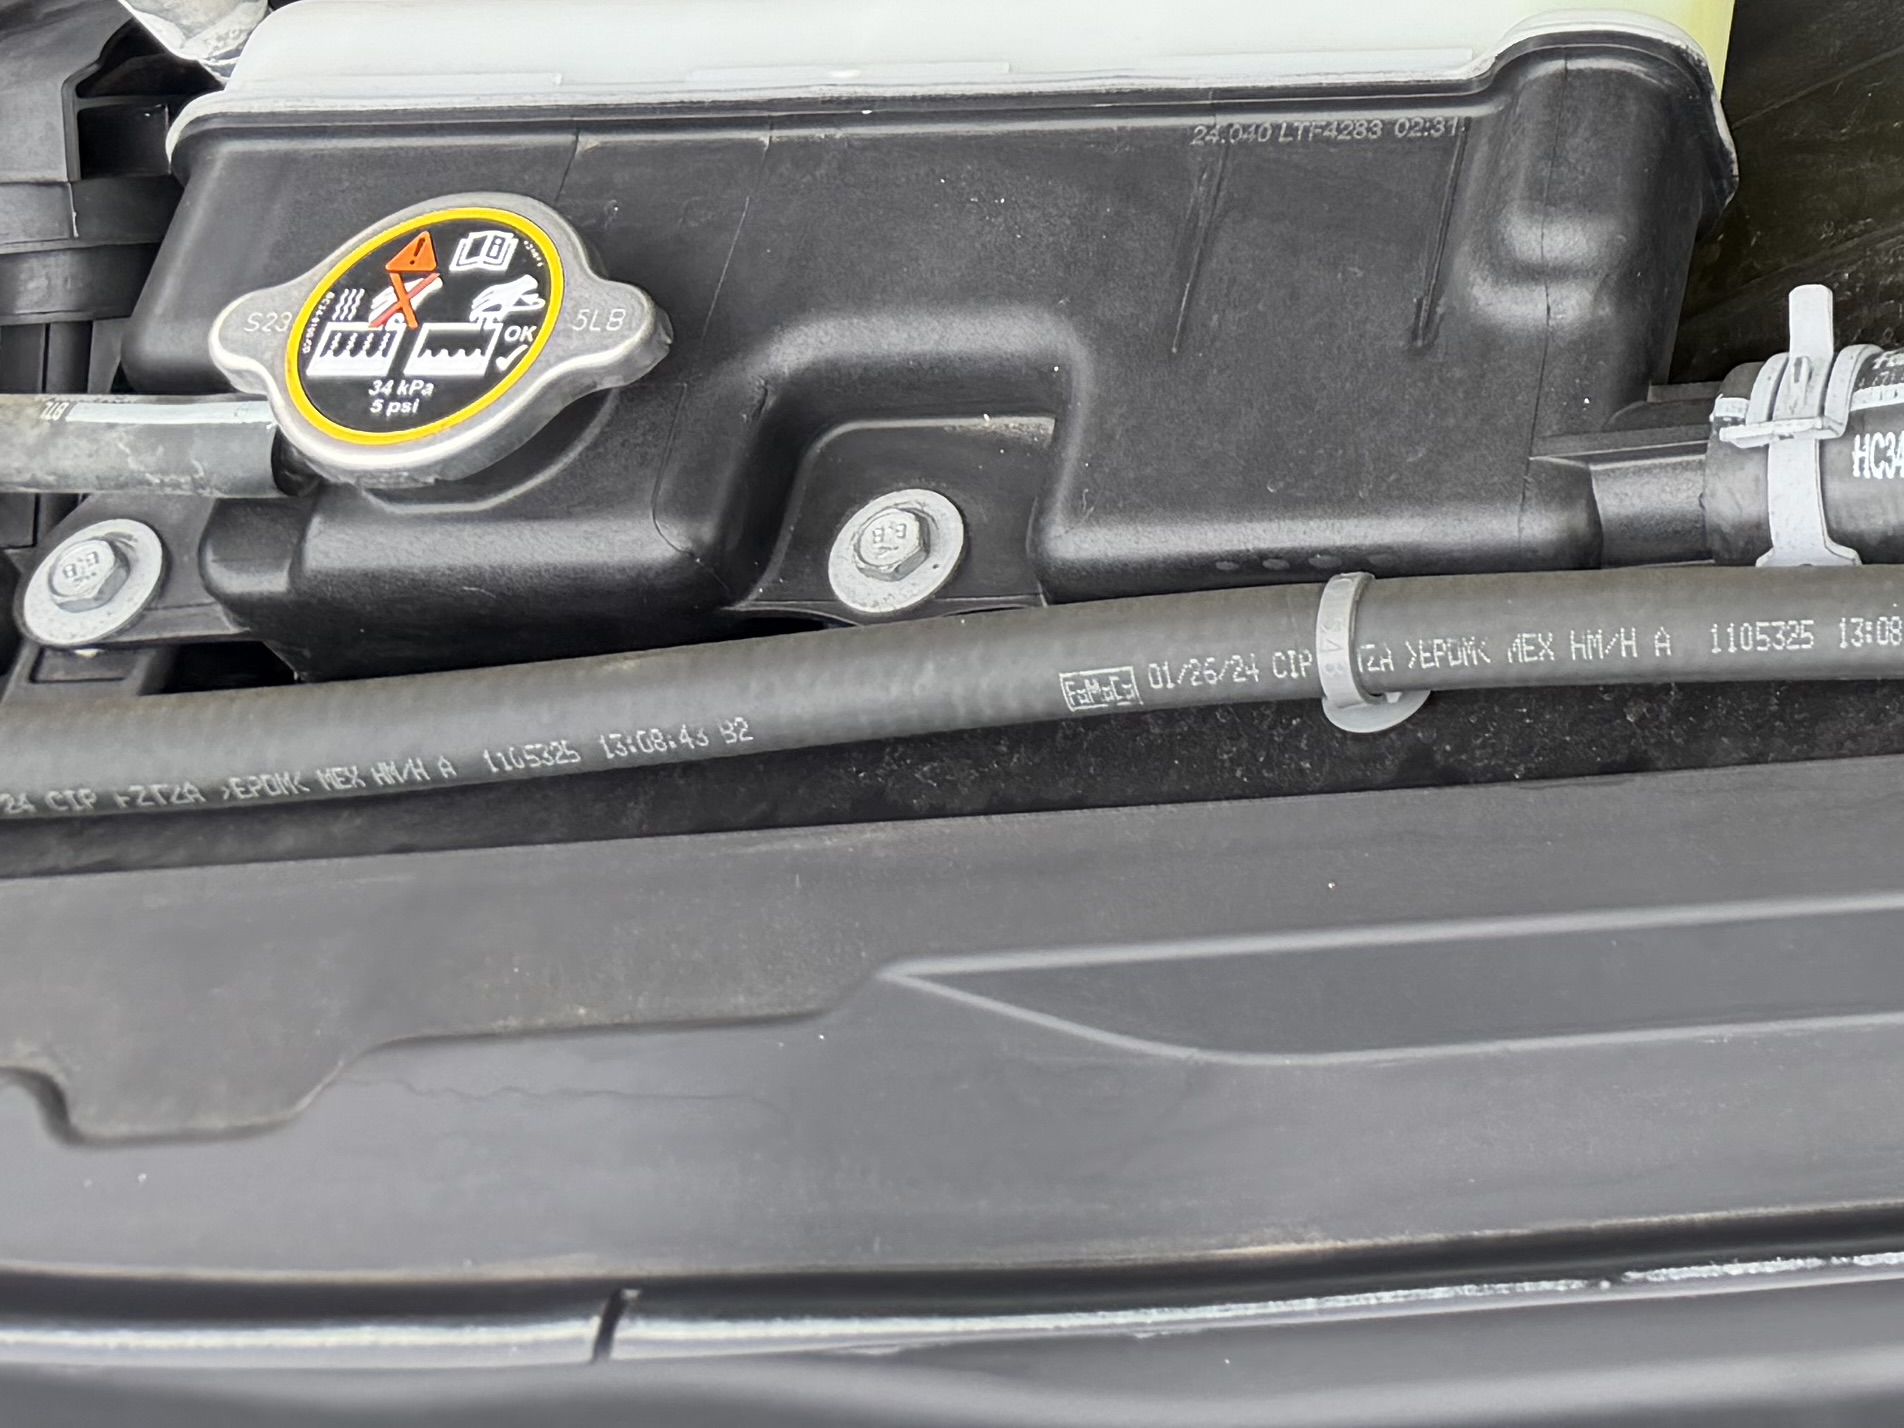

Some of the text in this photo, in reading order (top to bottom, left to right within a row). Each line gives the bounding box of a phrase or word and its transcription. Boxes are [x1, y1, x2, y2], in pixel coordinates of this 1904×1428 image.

[244, 311, 292, 332] S23
[572, 308, 627, 330] 5LB
[505, 326, 536, 342] OK
[369, 379, 434, 397] 34 kPa
[370, 398, 420, 417] 5 psi
[1147, 653, 1260, 690] 01/26/24
[1507, 632, 1555, 664] MEX
[1569, 627, 1638, 661] HM/H
[1655, 626, 1672, 657] A
[1710, 619, 1815, 654] 1105325
[316, 765, 366, 792] MEX
[437, 755, 456, 778] A
[483, 739, 581, 773] 1105325
